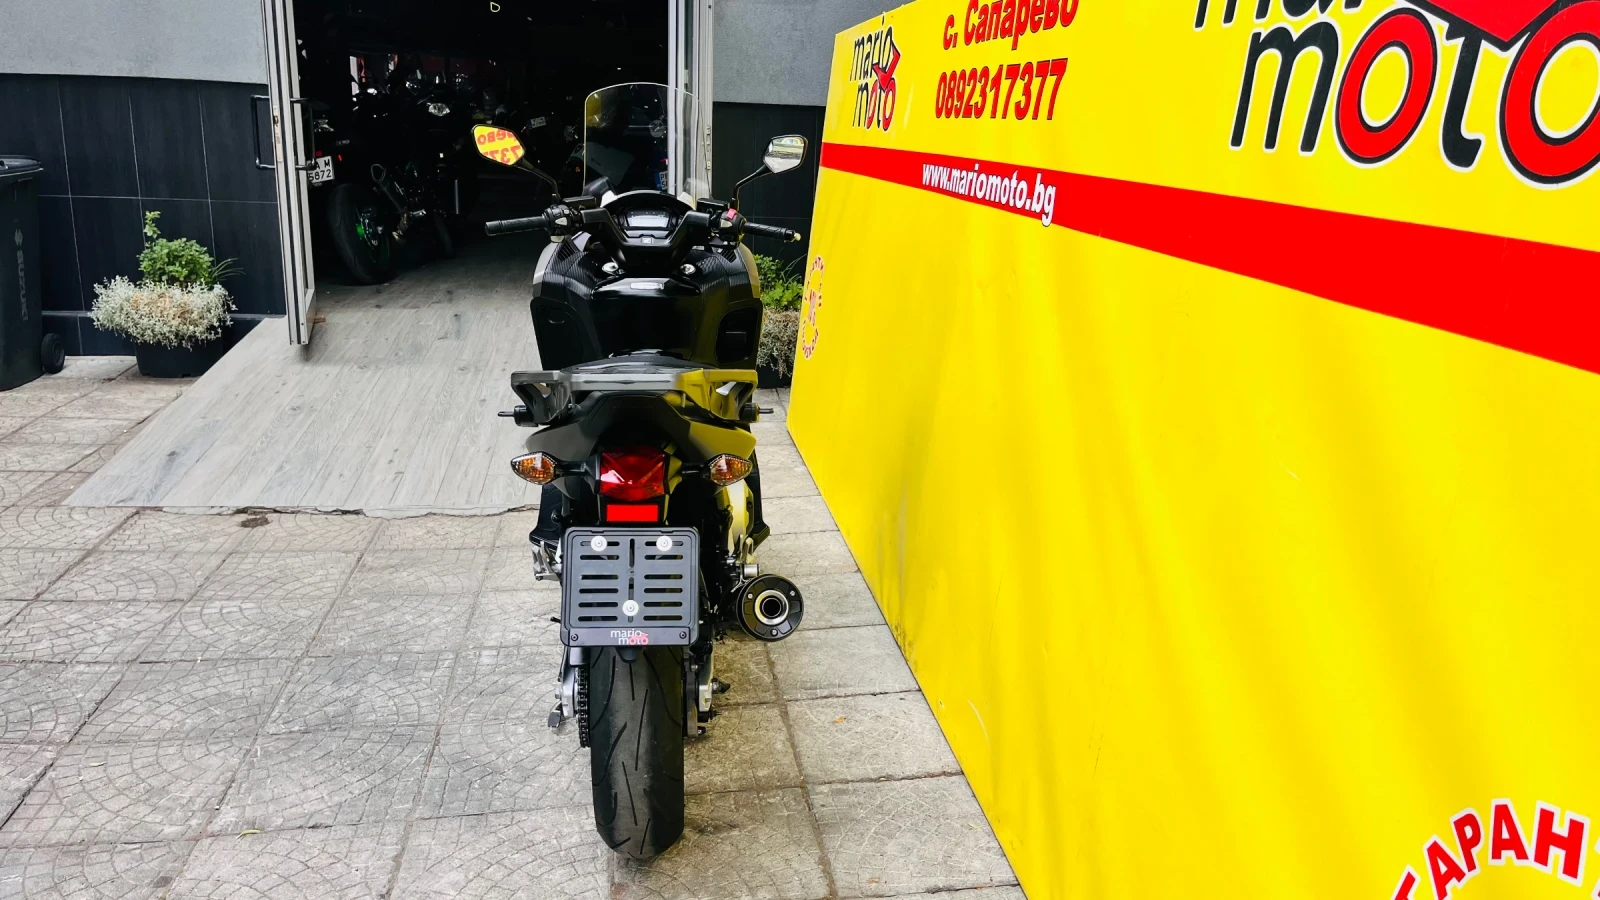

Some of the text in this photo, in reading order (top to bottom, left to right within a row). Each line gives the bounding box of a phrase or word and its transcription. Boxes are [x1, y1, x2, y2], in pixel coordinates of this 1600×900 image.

[849, 15, 893, 81] mario
[964, 0, 1080, 51] Сапарево
[853, 78, 896, 131] moto
[935, 58, 1068, 120] 0892317377
[1230, 0, 1600, 185] moto
[308, 168, 331, 180] 5872
[922, 163, 1056, 227] www.mariomoto.bg
[16, 250, 28, 321] SUZUKI
[611, 629, 642, 637] mario
[618, 636, 649, 645] moto
[1392, 801, 1600, 900] АРАН
